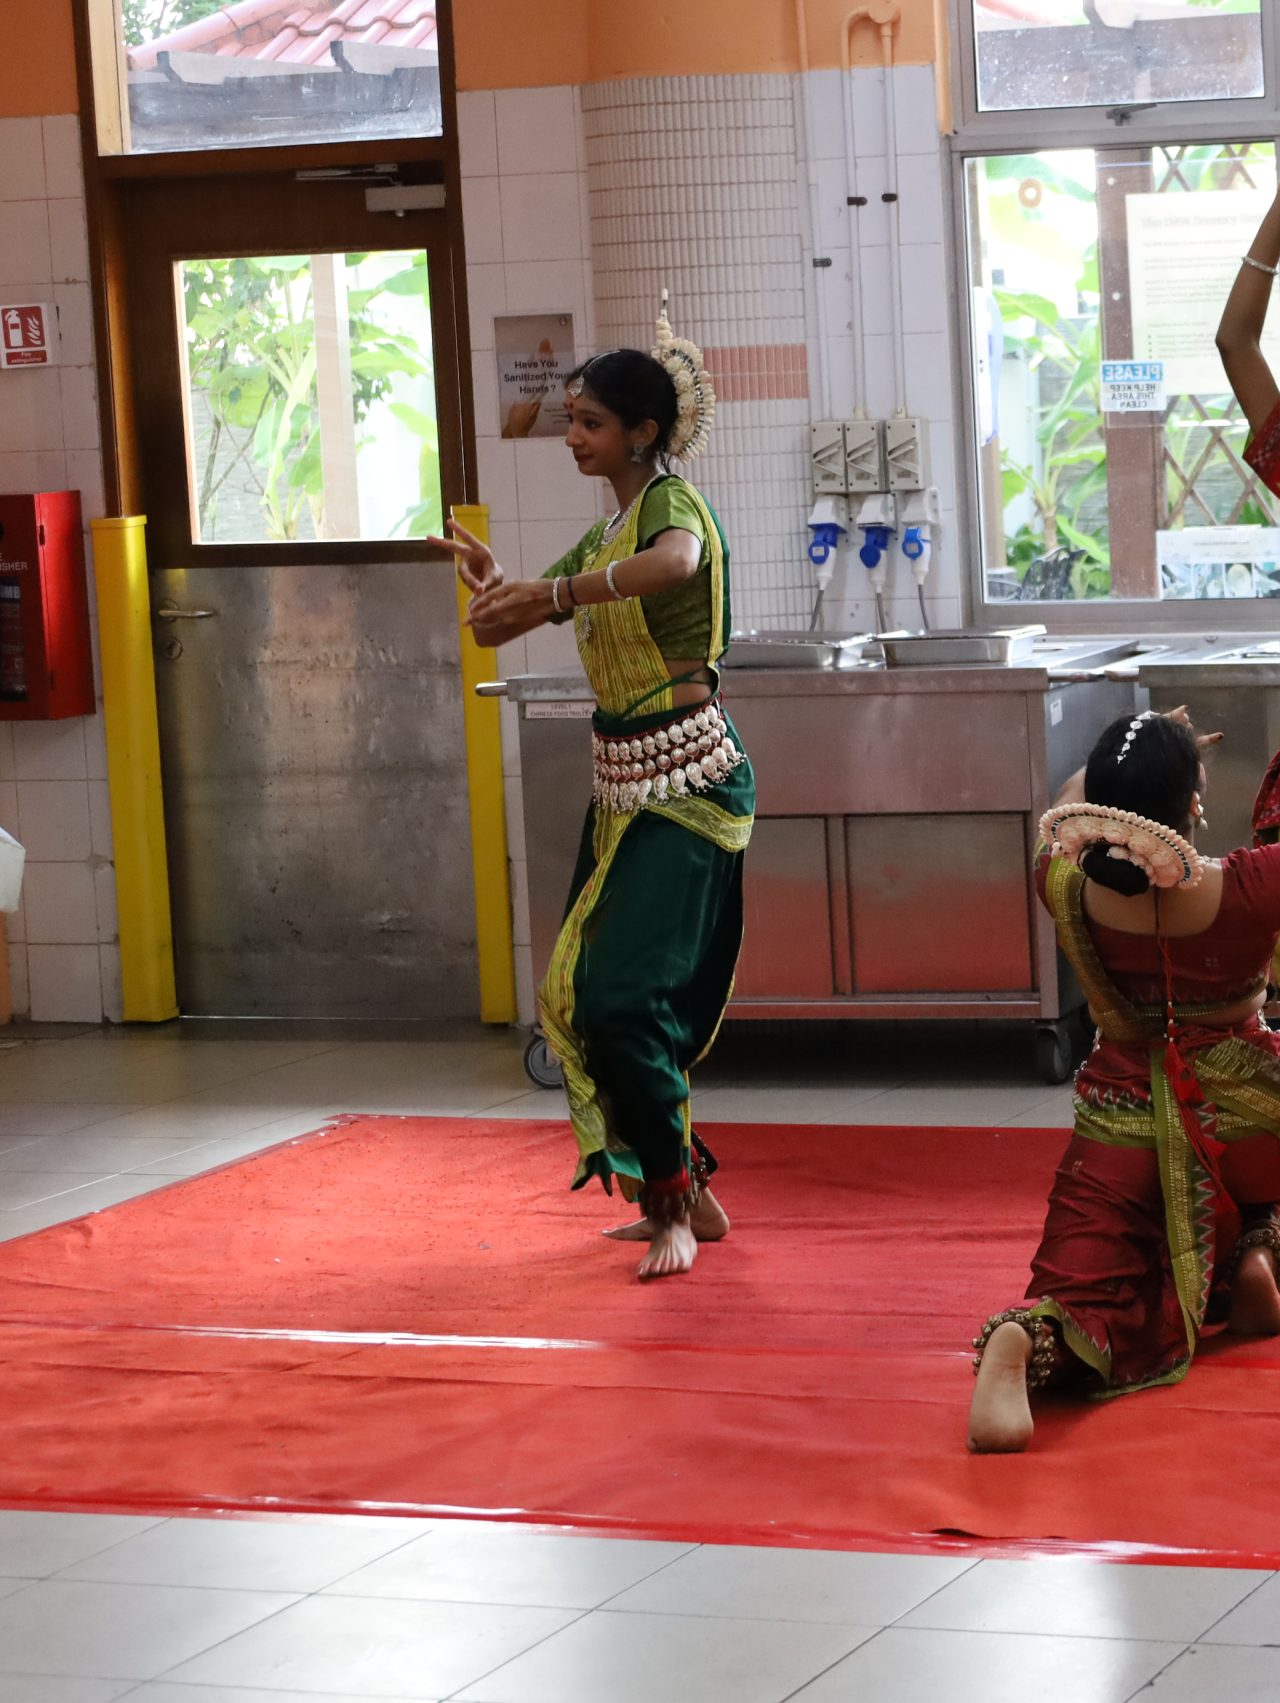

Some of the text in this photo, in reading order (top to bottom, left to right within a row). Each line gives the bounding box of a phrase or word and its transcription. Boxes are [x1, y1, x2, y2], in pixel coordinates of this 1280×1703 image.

[515, 360, 559, 369] Have You
[504, 373, 547, 382] Sanitized
[520, 385, 549, 394] Hands
